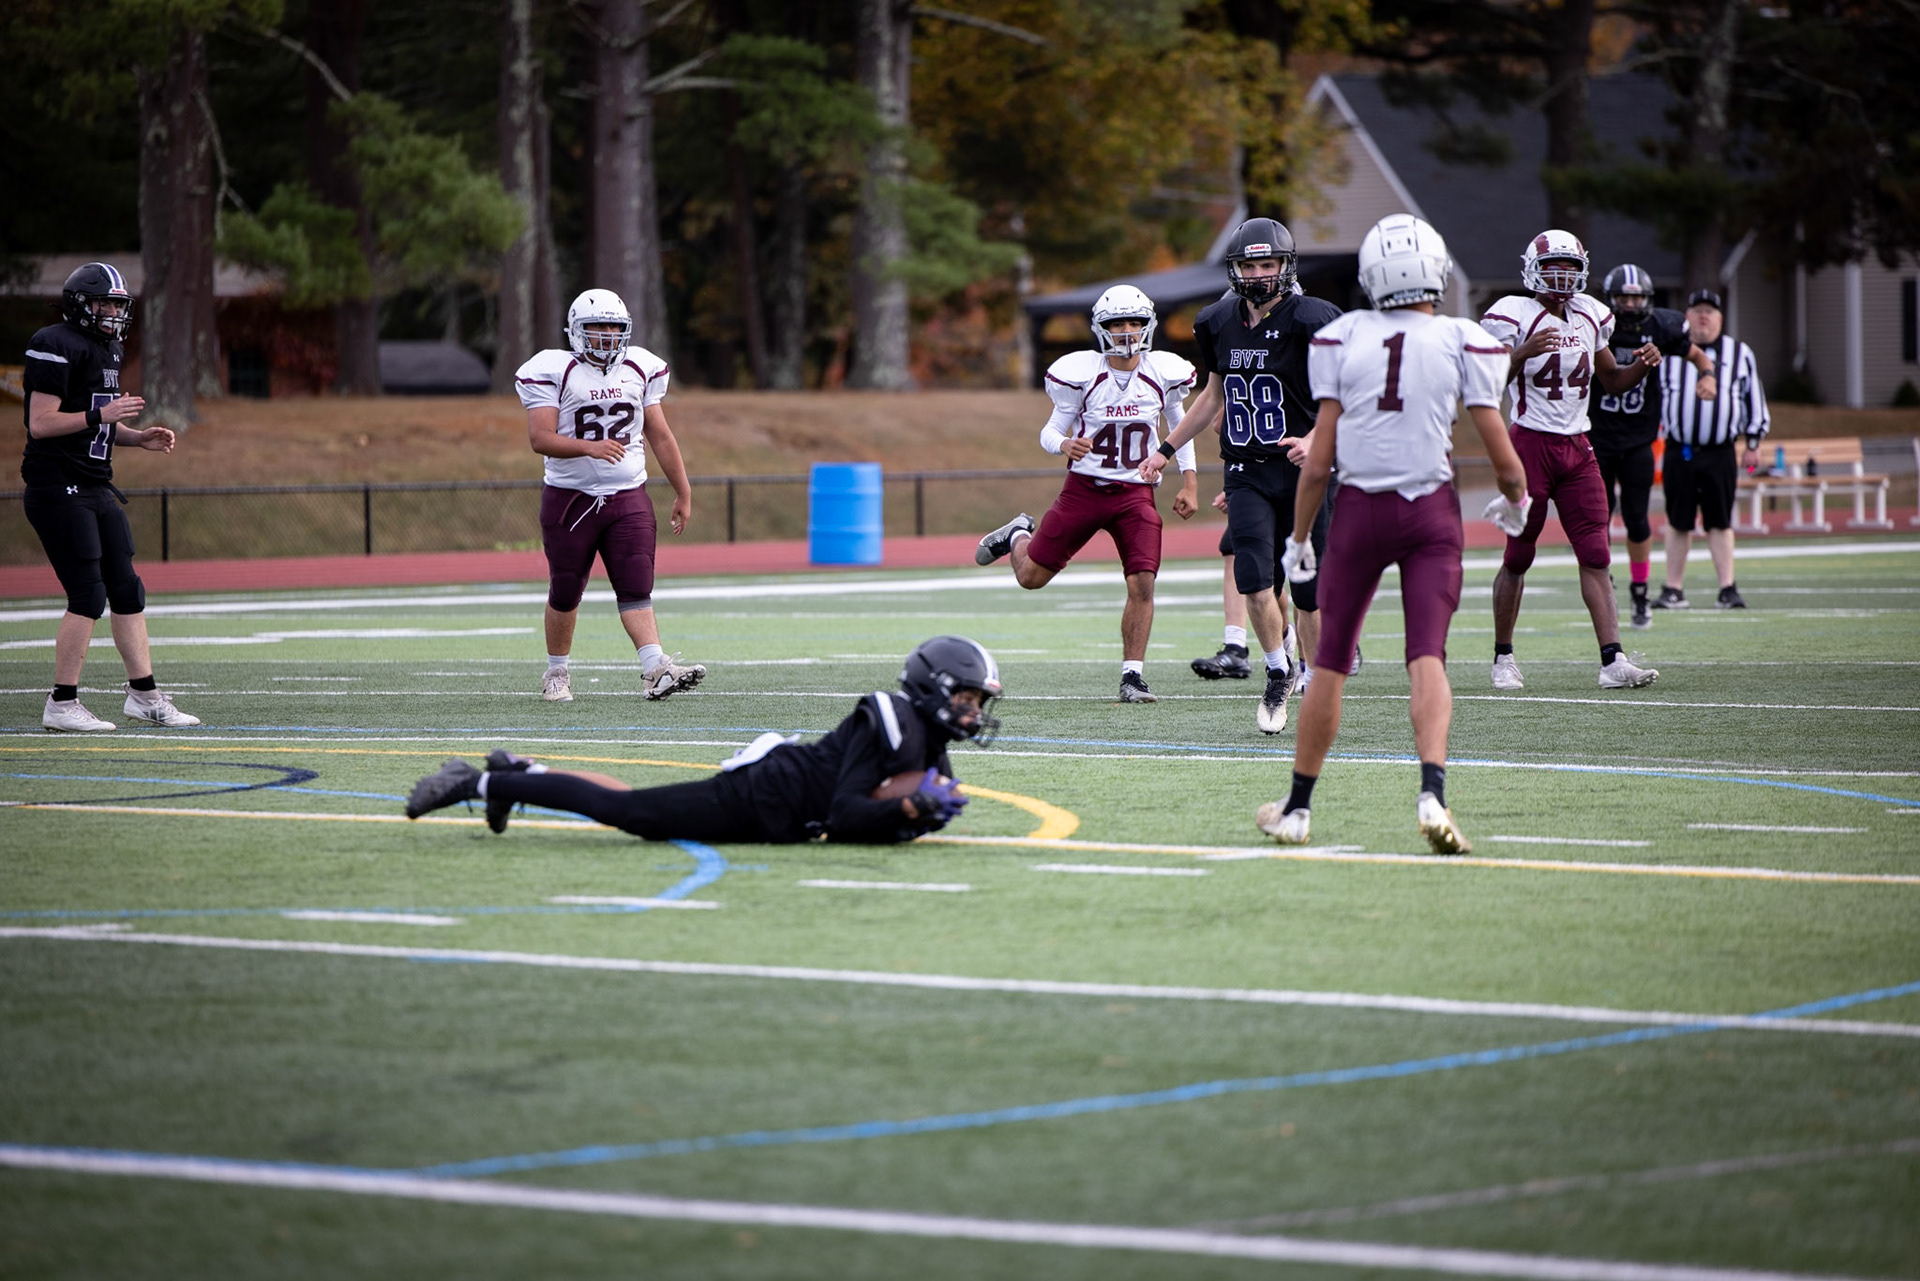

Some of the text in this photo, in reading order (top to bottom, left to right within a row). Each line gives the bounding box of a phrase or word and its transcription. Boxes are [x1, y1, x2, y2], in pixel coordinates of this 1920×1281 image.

[103, 368, 119, 388] BVT
[1230, 349, 1269, 369] BVT
[1377, 332, 1406, 412] 1
[1533, 351, 1590, 400] 44
[589, 388, 623, 400] RAMS
[1106, 405, 1140, 417] RAMS
[1223, 374, 1286, 446] 68
[574, 402, 635, 446] 62
[1091, 422, 1151, 470] 40
